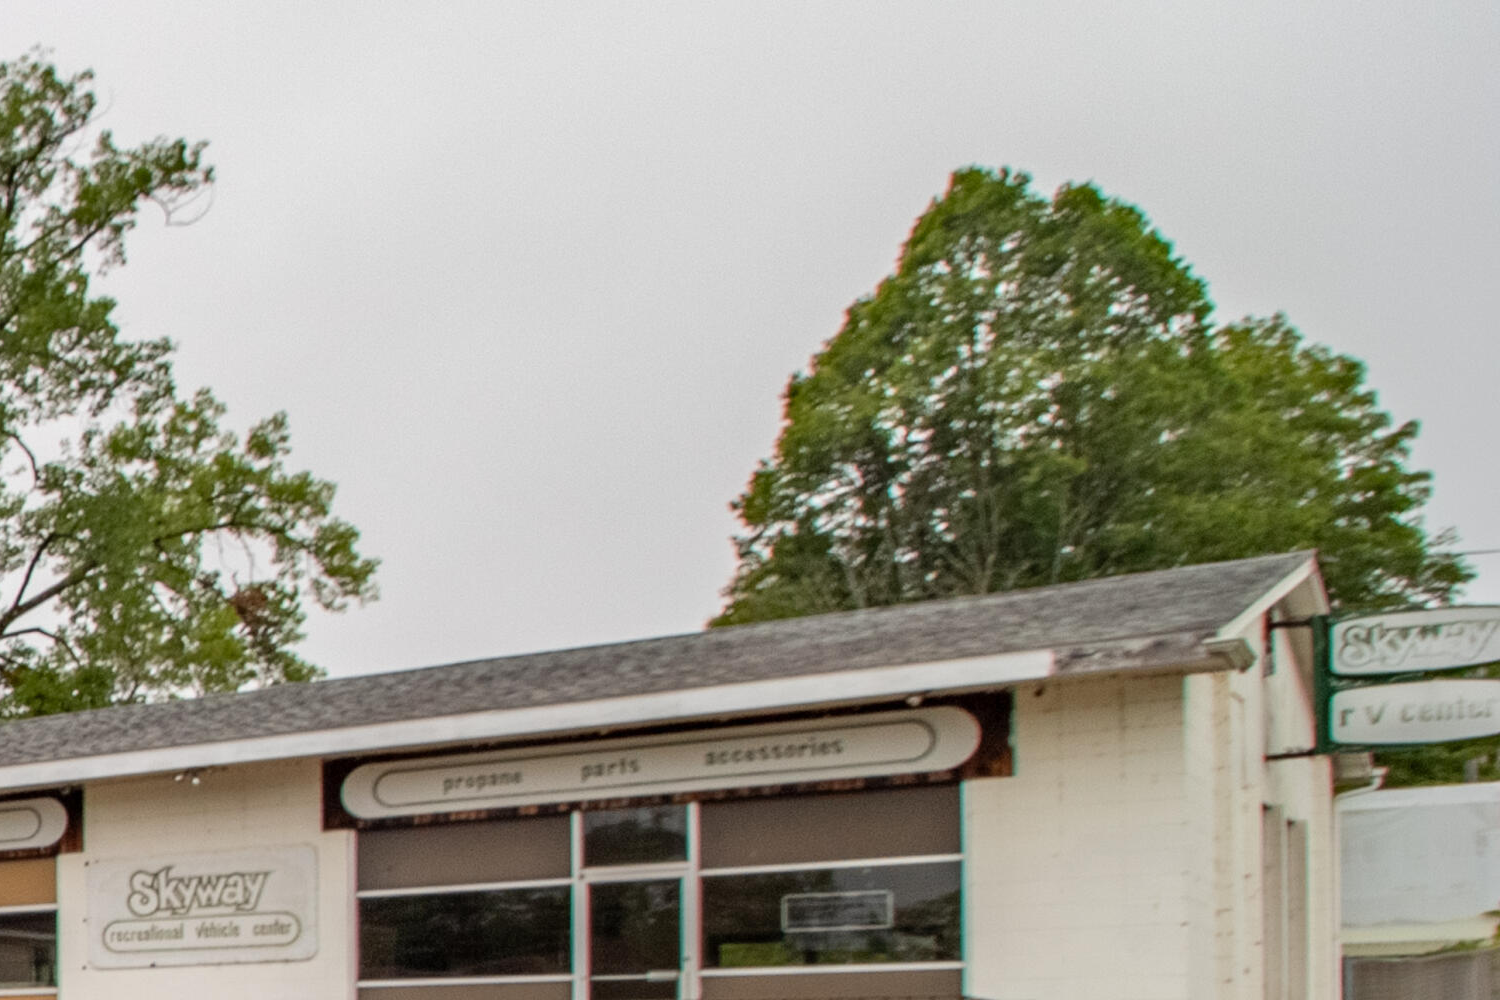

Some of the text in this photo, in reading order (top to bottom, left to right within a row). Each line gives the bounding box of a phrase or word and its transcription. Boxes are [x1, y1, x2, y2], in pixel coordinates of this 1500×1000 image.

[1339, 619, 1500, 668] Skyway
[1401, 697, 1497, 722] center
[443, 737, 844, 795] propane parts accessories
[127, 865, 275, 917] Skyway
[110, 922, 184, 942] recreational
[252, 918, 292, 937] center
